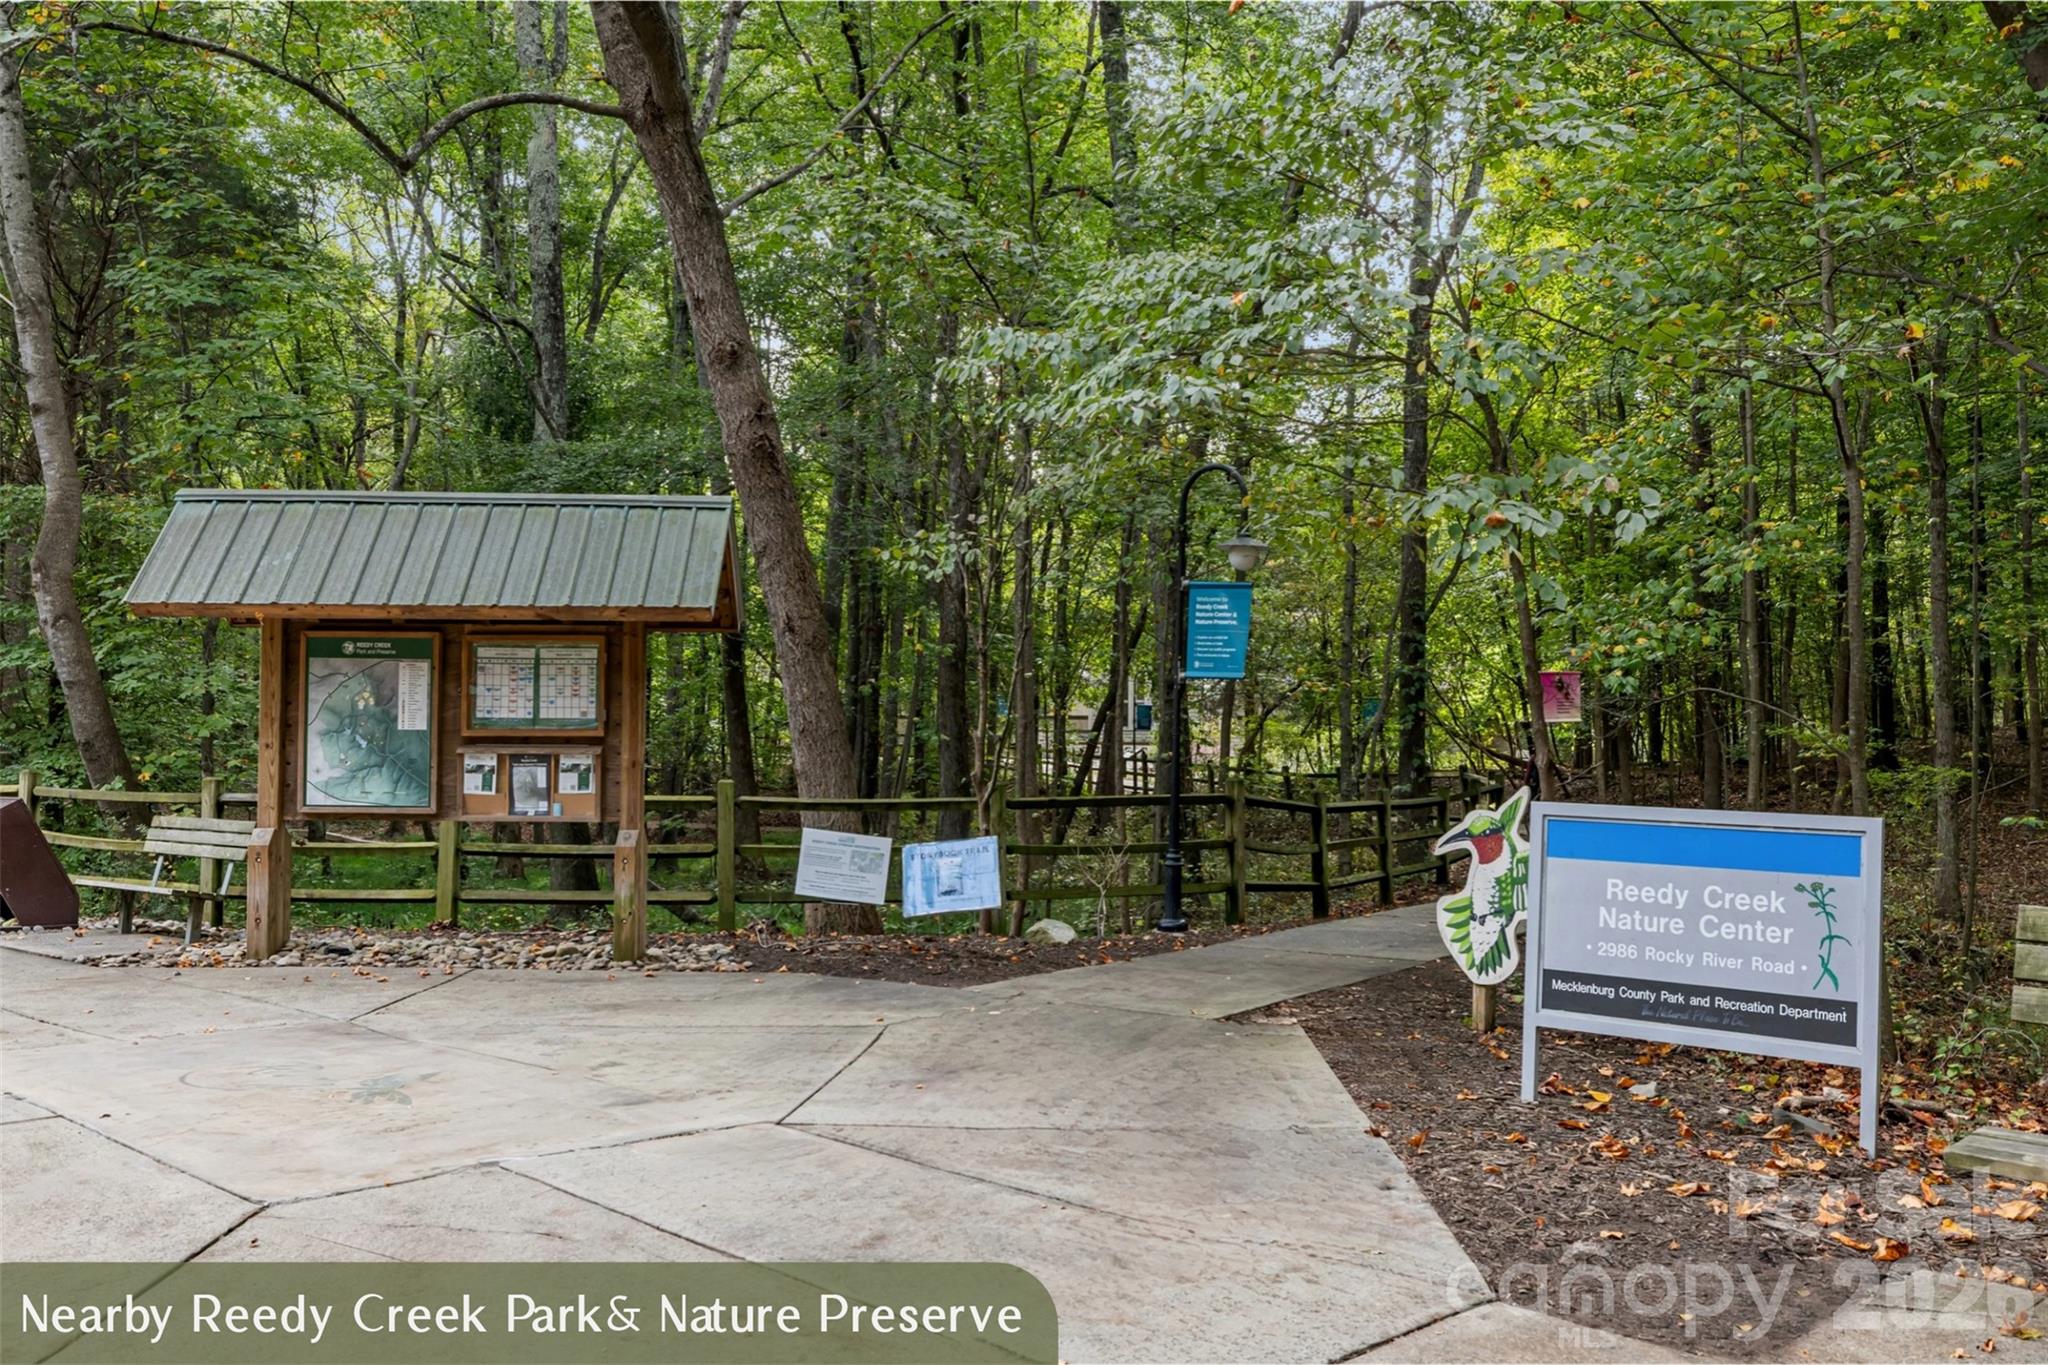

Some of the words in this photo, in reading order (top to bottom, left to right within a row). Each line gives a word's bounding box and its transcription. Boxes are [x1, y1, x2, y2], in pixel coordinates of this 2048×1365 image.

[1606, 878, 1689, 909] Reedy
[1703, 885, 1786, 914] Creek
[1599, 906, 1685, 935] Nature
[1699, 915, 1794, 945] Center
[1597, 942, 1638, 960] 2986
[1645, 947, 1694, 968] Rocky
[1702, 951, 1743, 970] River
[1751, 956, 1794, 975] Road
[1551, 978, 1615, 999] Mecklenburg
[1619, 986, 1656, 1004] County
[1660, 990, 1685, 1005] Park
[1689, 993, 1710, 1008] and
[1714, 996, 1775, 1016] Recreation
[1779, 1002, 1847, 1023] Department
